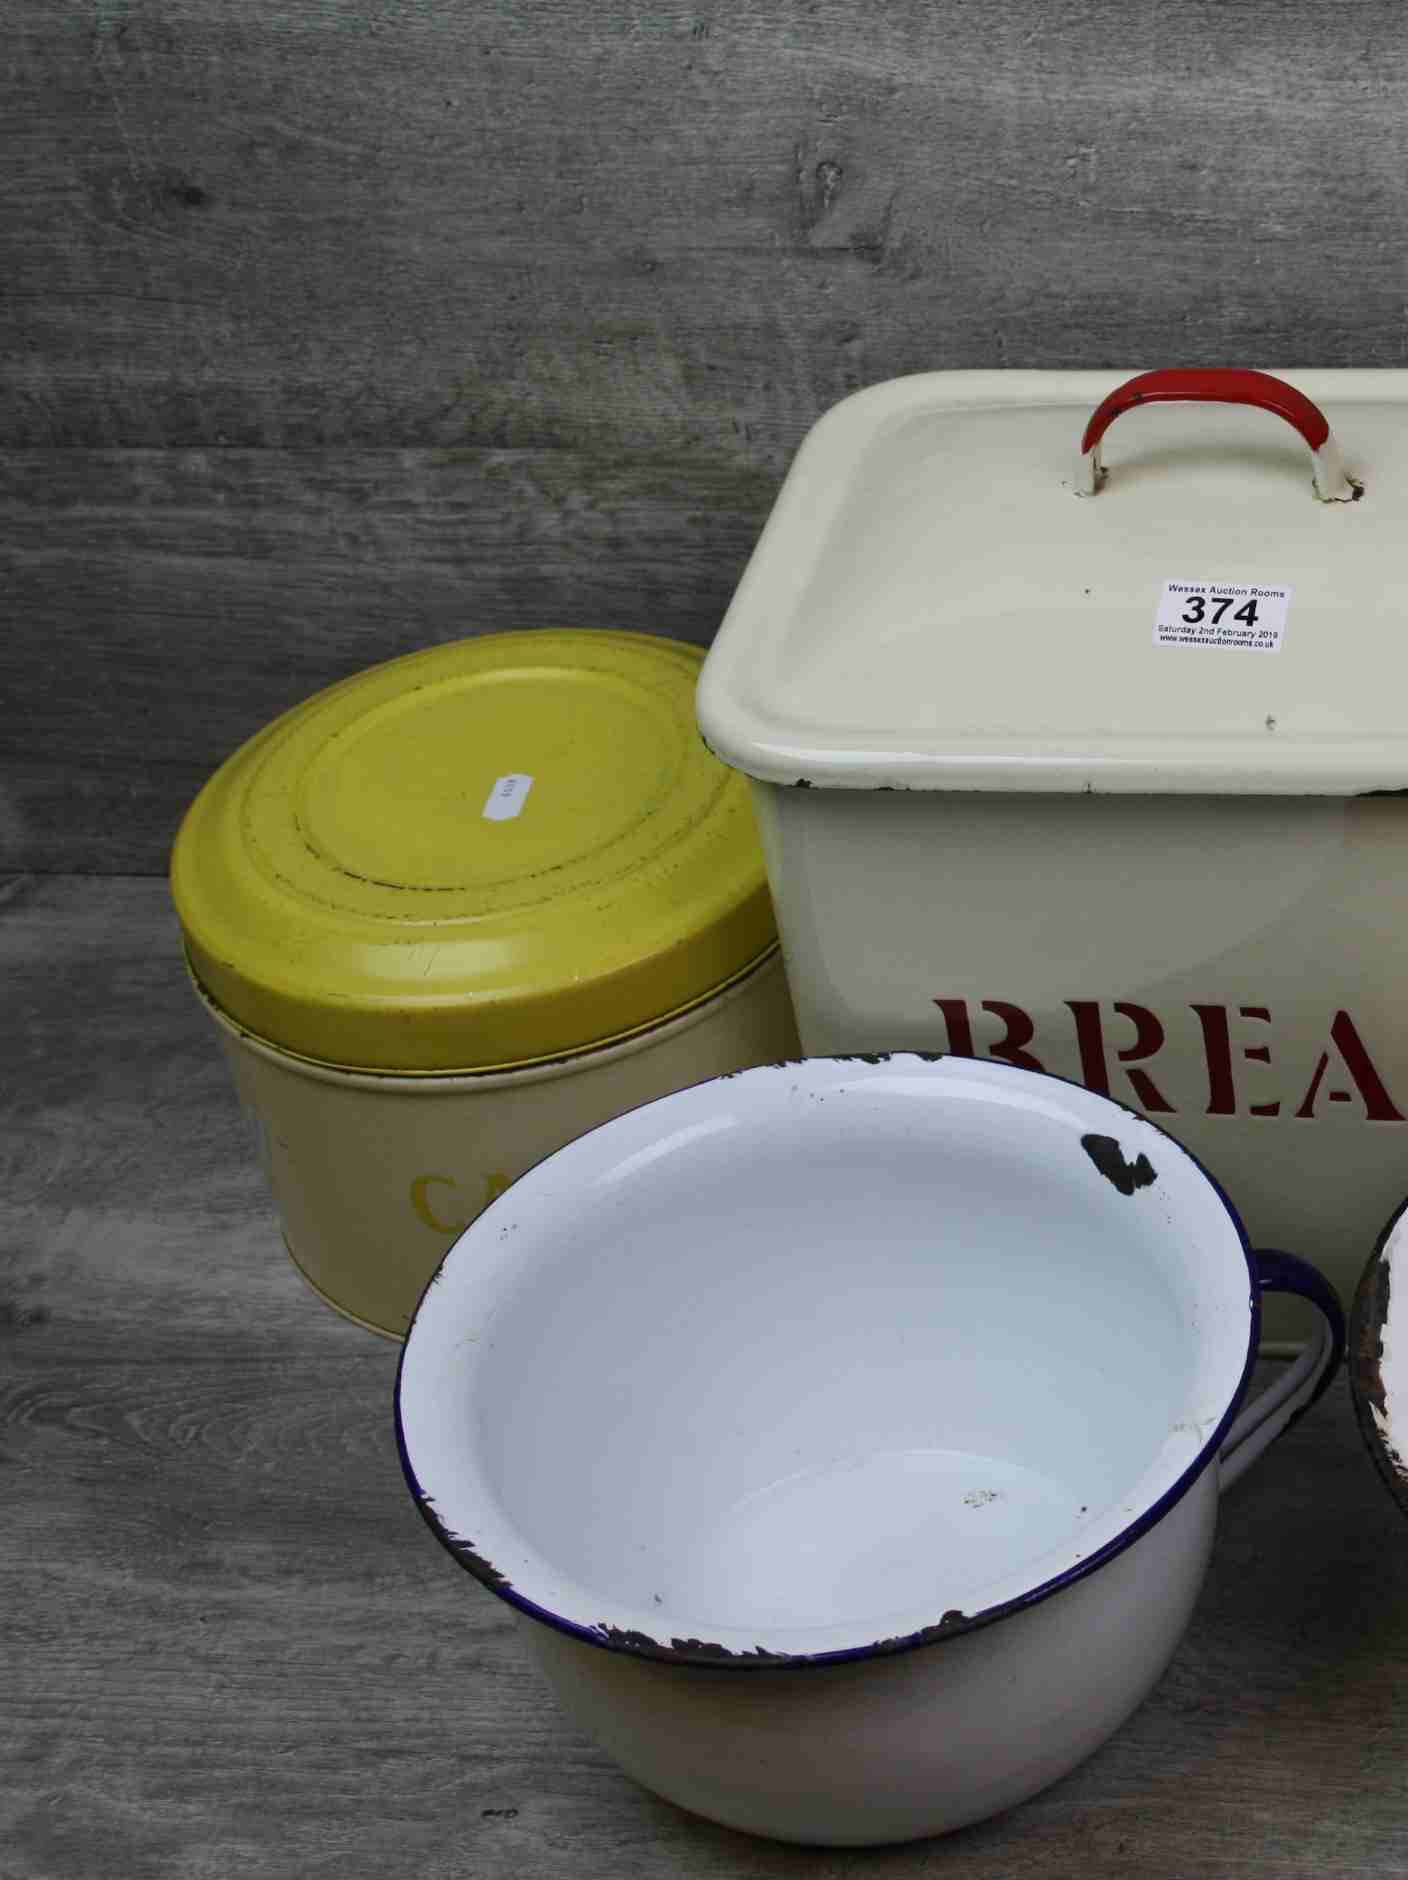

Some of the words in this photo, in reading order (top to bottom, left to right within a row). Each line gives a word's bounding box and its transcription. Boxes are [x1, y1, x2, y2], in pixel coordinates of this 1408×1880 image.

[1168, 584, 1206, 594] Wessex
[1209, 586, 1248, 597] Auction
[1250, 588, 1285, 598] Rooms
[1181, 596, 1259, 627] 374
[1158, 624, 1196, 636] Saturday
[1198, 626, 1216, 636] 2nd
[1217, 627, 1257, 640] February
[1258, 629, 1279, 640] 2019
